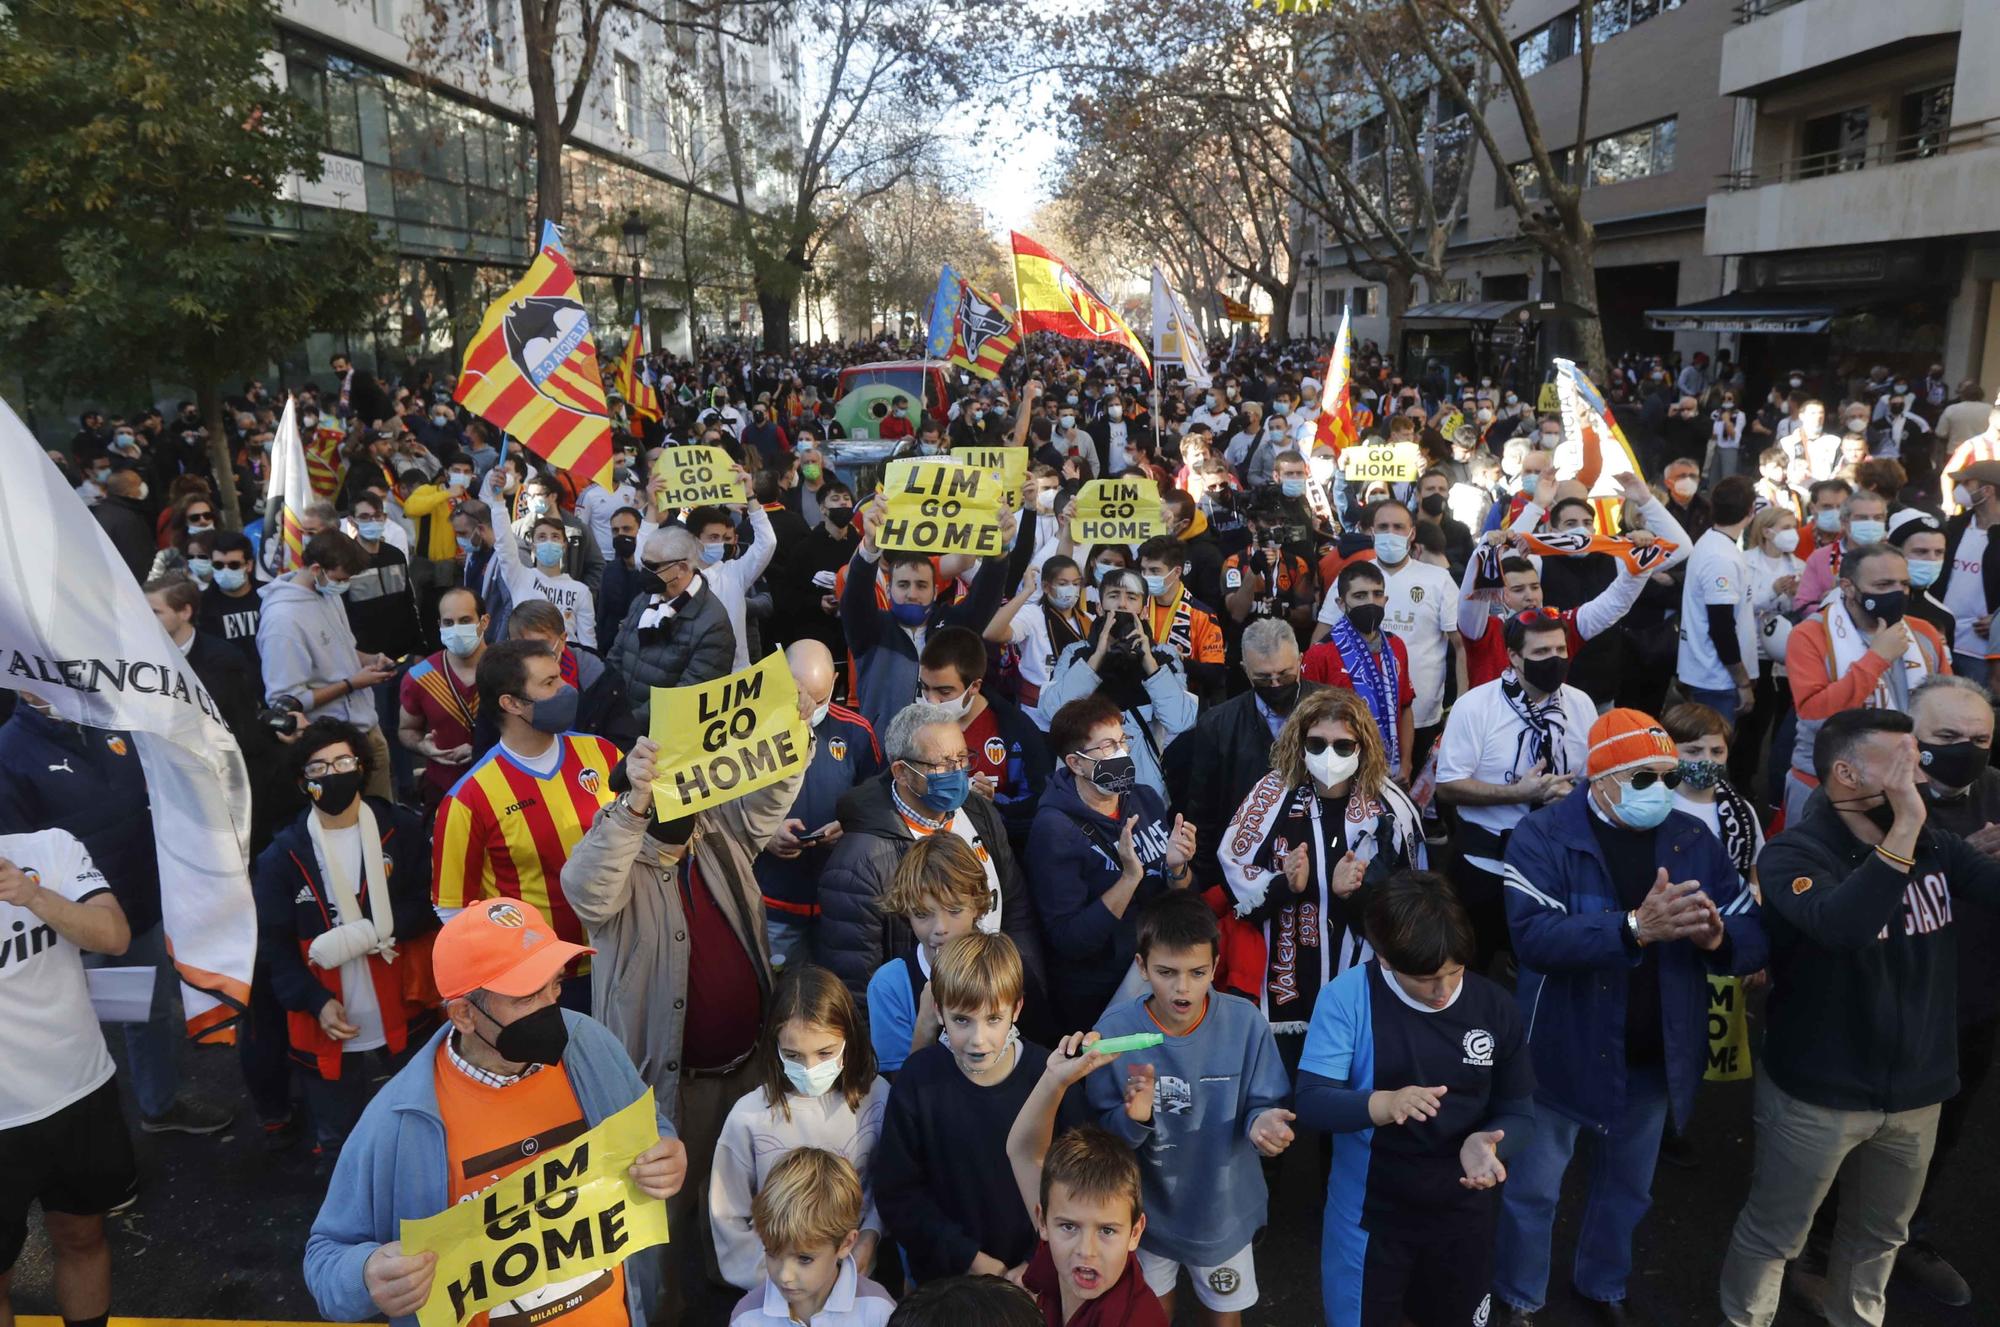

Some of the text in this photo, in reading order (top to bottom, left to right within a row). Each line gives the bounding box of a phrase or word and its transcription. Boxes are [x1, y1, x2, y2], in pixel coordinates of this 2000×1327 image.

[673, 450, 713, 467] LIM
[967, 452, 1004, 468] LIM
[1368, 450, 1394, 462] GO
[680, 467, 712, 485] GO
[1355, 464, 1406, 477] HOME
[904, 466, 981, 498] LIM
[665, 484, 733, 503] HOME
[1099, 484, 1138, 501] LIM
[921, 498, 962, 518] GO
[1100, 503, 1135, 519] GO
[880, 519, 998, 551] HOME
[1083, 522, 1151, 539] HOME
[565, 590, 577, 606] CF
[699, 671, 763, 724] LIM
[703, 707, 756, 752] GO
[675, 730, 799, 805] HOME
[1300, 903, 1318, 946] 1919
[484, 1142, 589, 1225] LIM
[485, 1185, 579, 1240] GO
[447, 1200, 629, 1324] HOME
[530, 1295, 583, 1323] MILANO 2001
